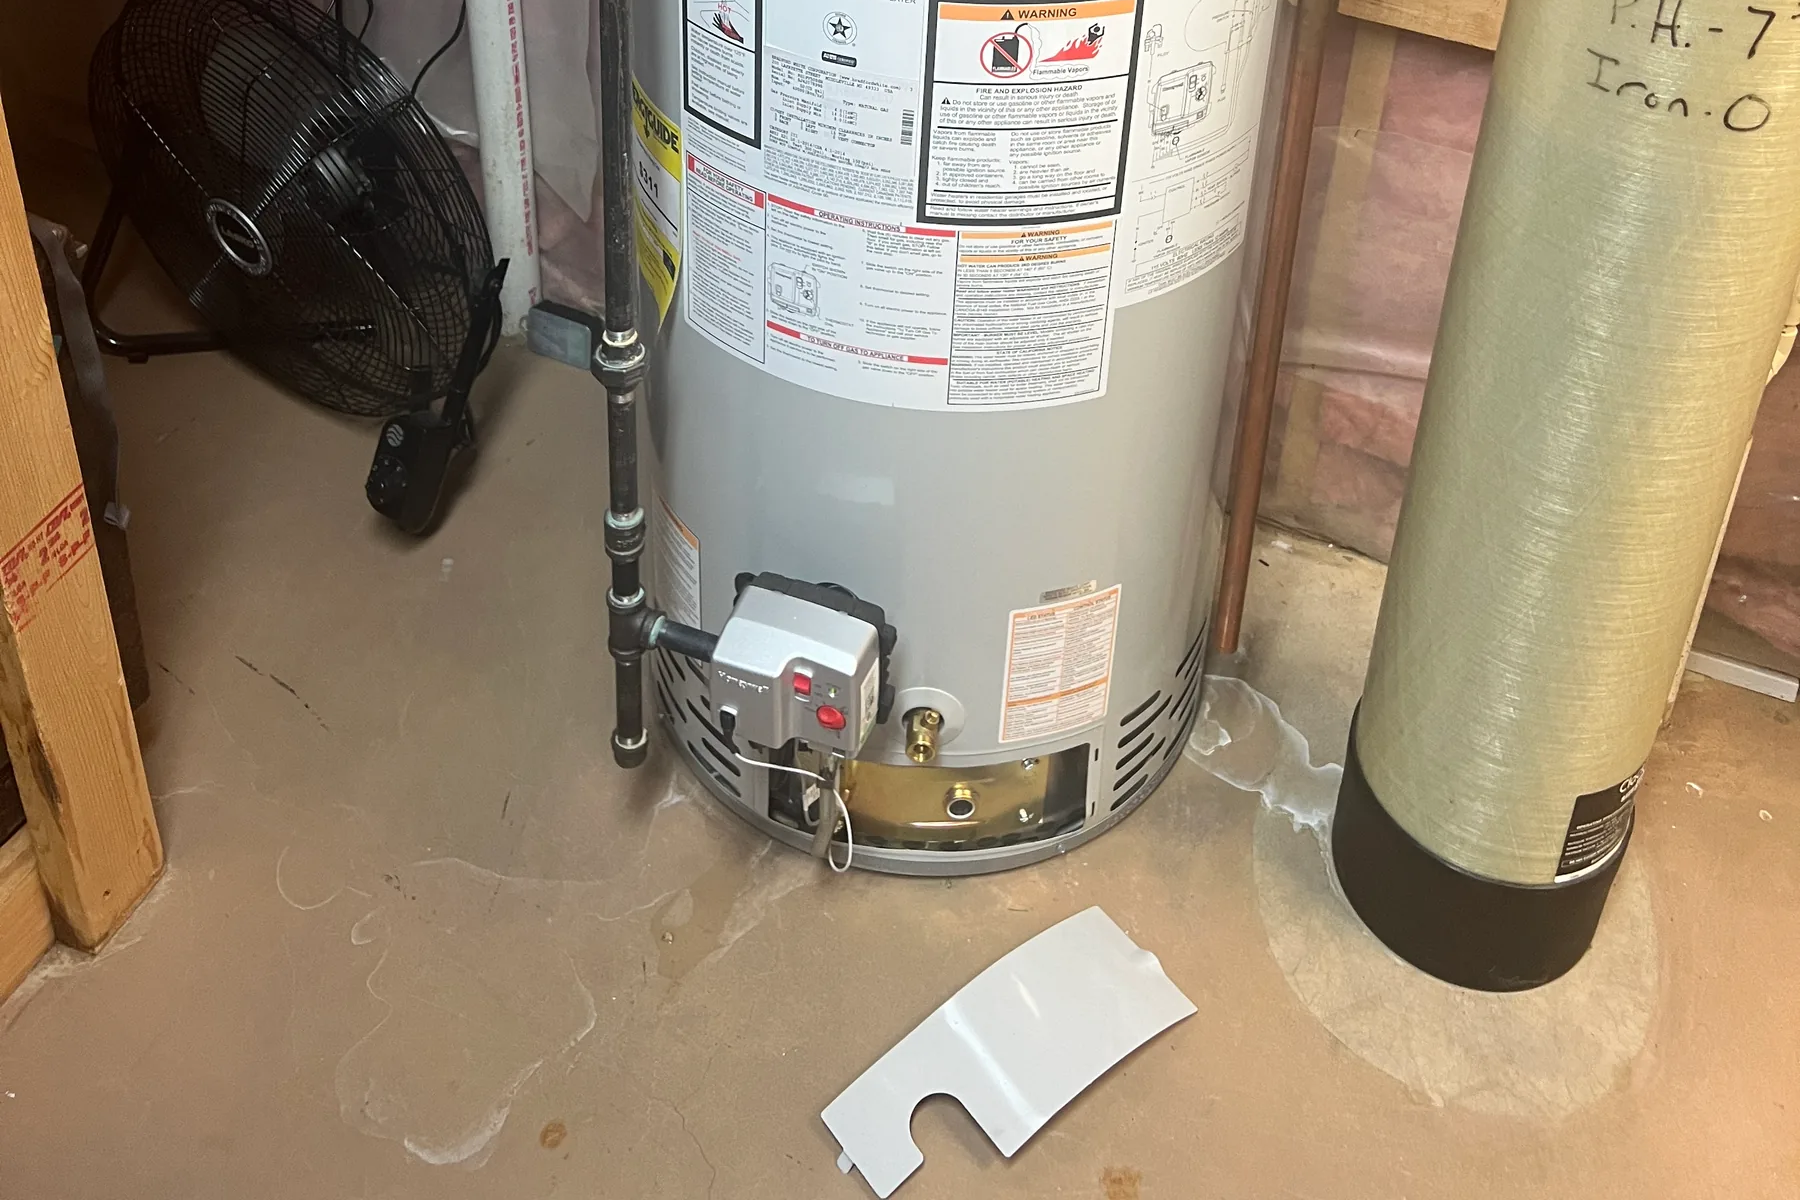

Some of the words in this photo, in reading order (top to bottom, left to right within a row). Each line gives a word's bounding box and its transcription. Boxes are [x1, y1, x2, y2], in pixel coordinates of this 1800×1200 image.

[717, 3, 731, 13] HOT
[1018, 8, 1077, 19] WARNING
[726, 185, 753, 202] OPERATING
[818, 211, 854, 223] OPERATING
[854, 219, 901, 233] INSTRUCTIONS
[1027, 229, 1061, 238] WARNING
[1026, 253, 1059, 261] WARNING
[816, 337, 832, 347] TURN
[833, 342, 844, 350] OFF
[846, 345, 859, 355] GAS
[870, 351, 904, 361] APPLIANCE
